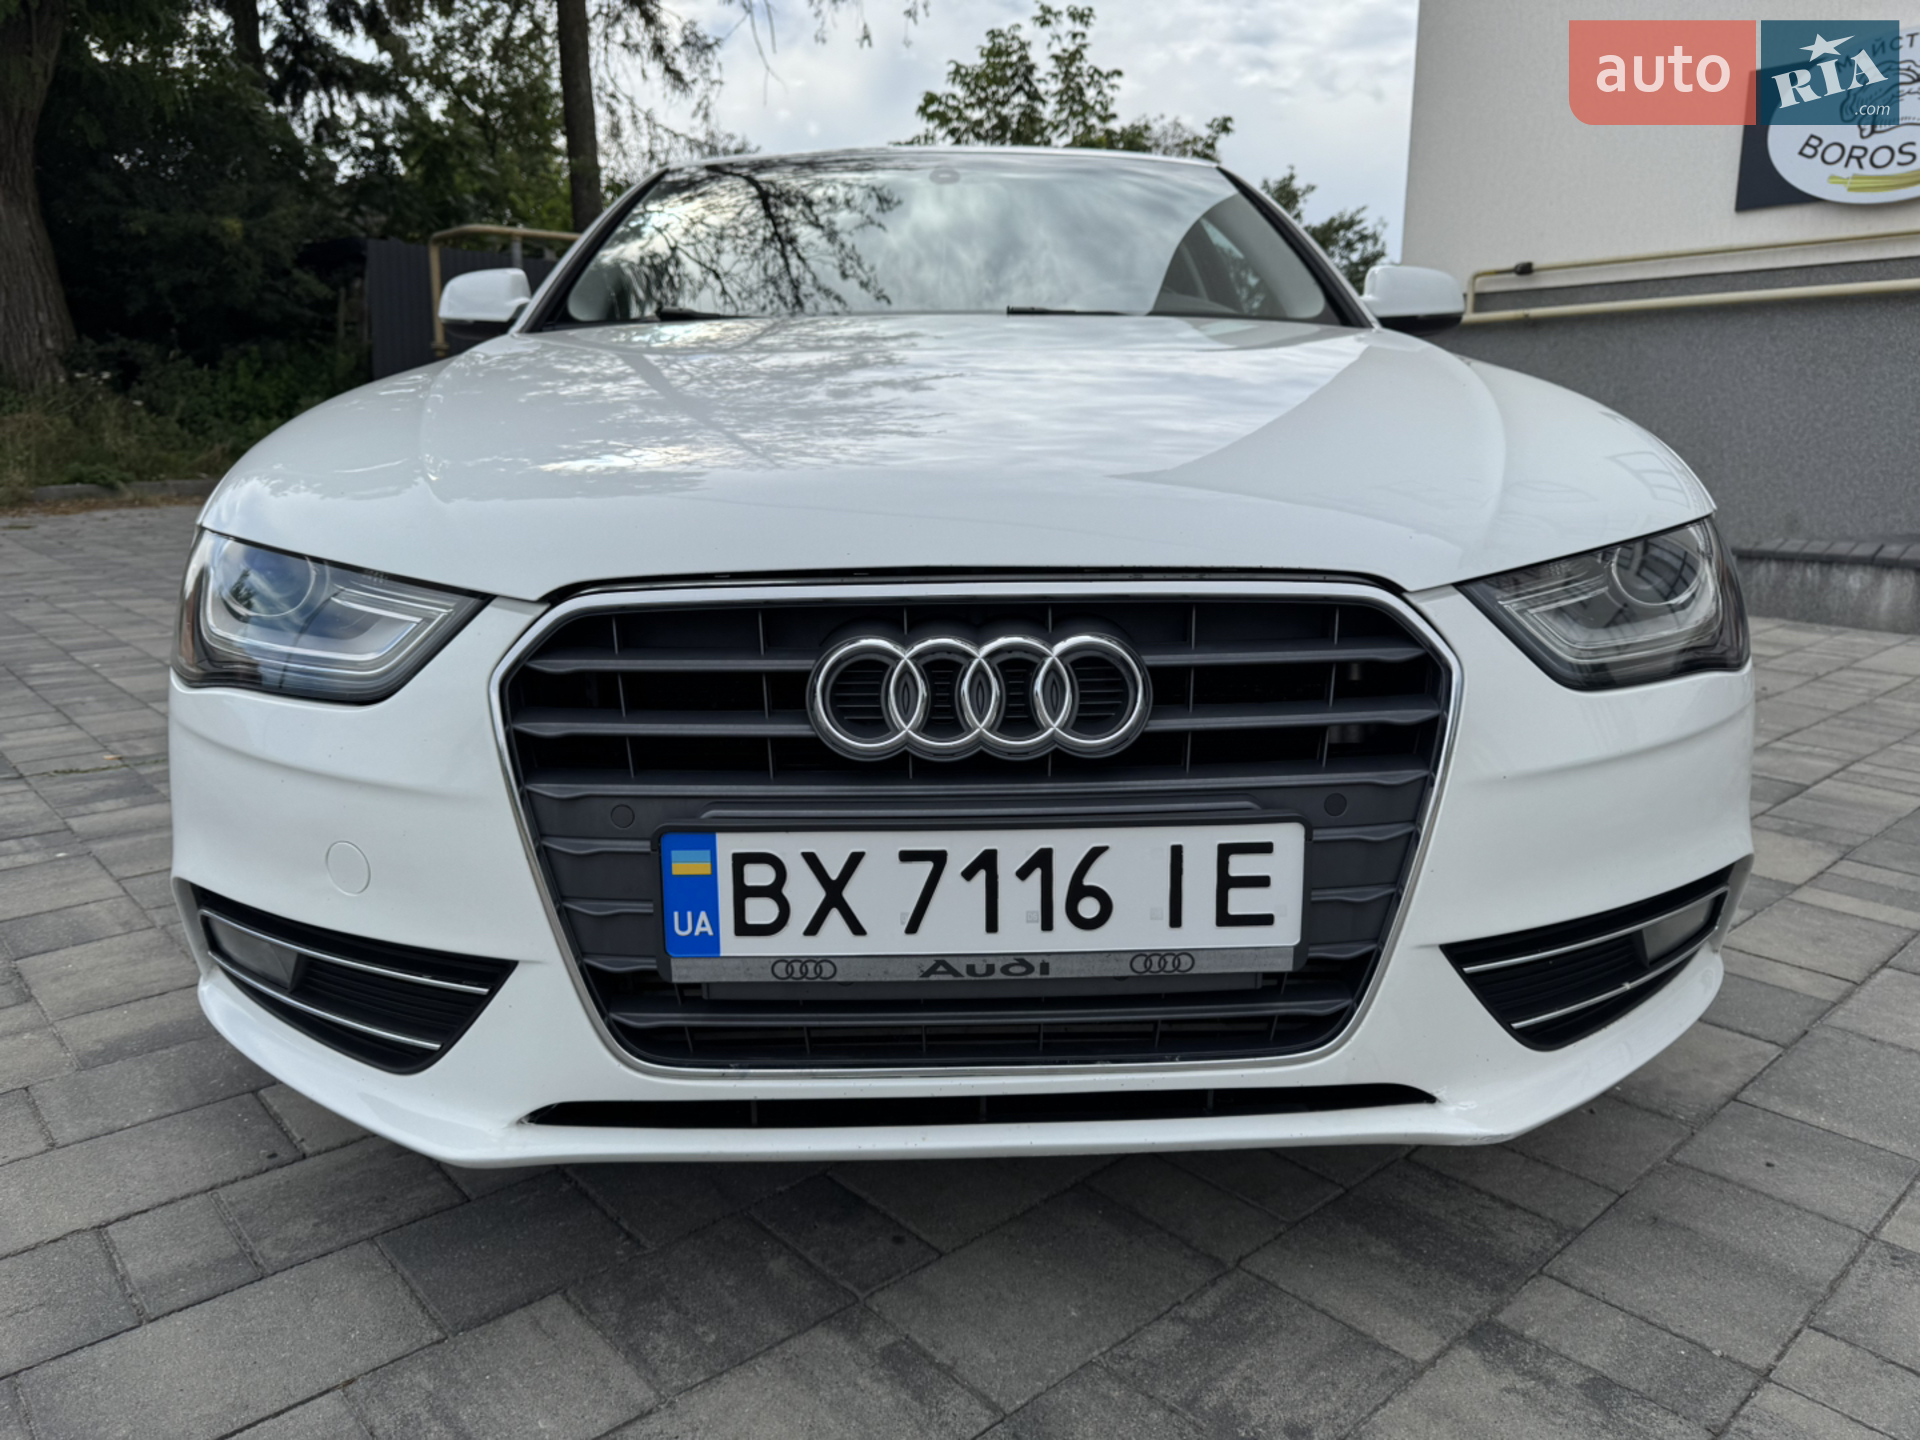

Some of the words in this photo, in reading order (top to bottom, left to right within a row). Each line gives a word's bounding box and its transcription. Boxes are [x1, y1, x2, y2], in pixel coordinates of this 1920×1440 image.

[731, 851, 867, 937] BX
[898, 845, 1113, 934] 7116
[1169, 841, 1275, 929] IE
[673, 911, 714, 936] UA
[919, 957, 1050, 978] Audi
